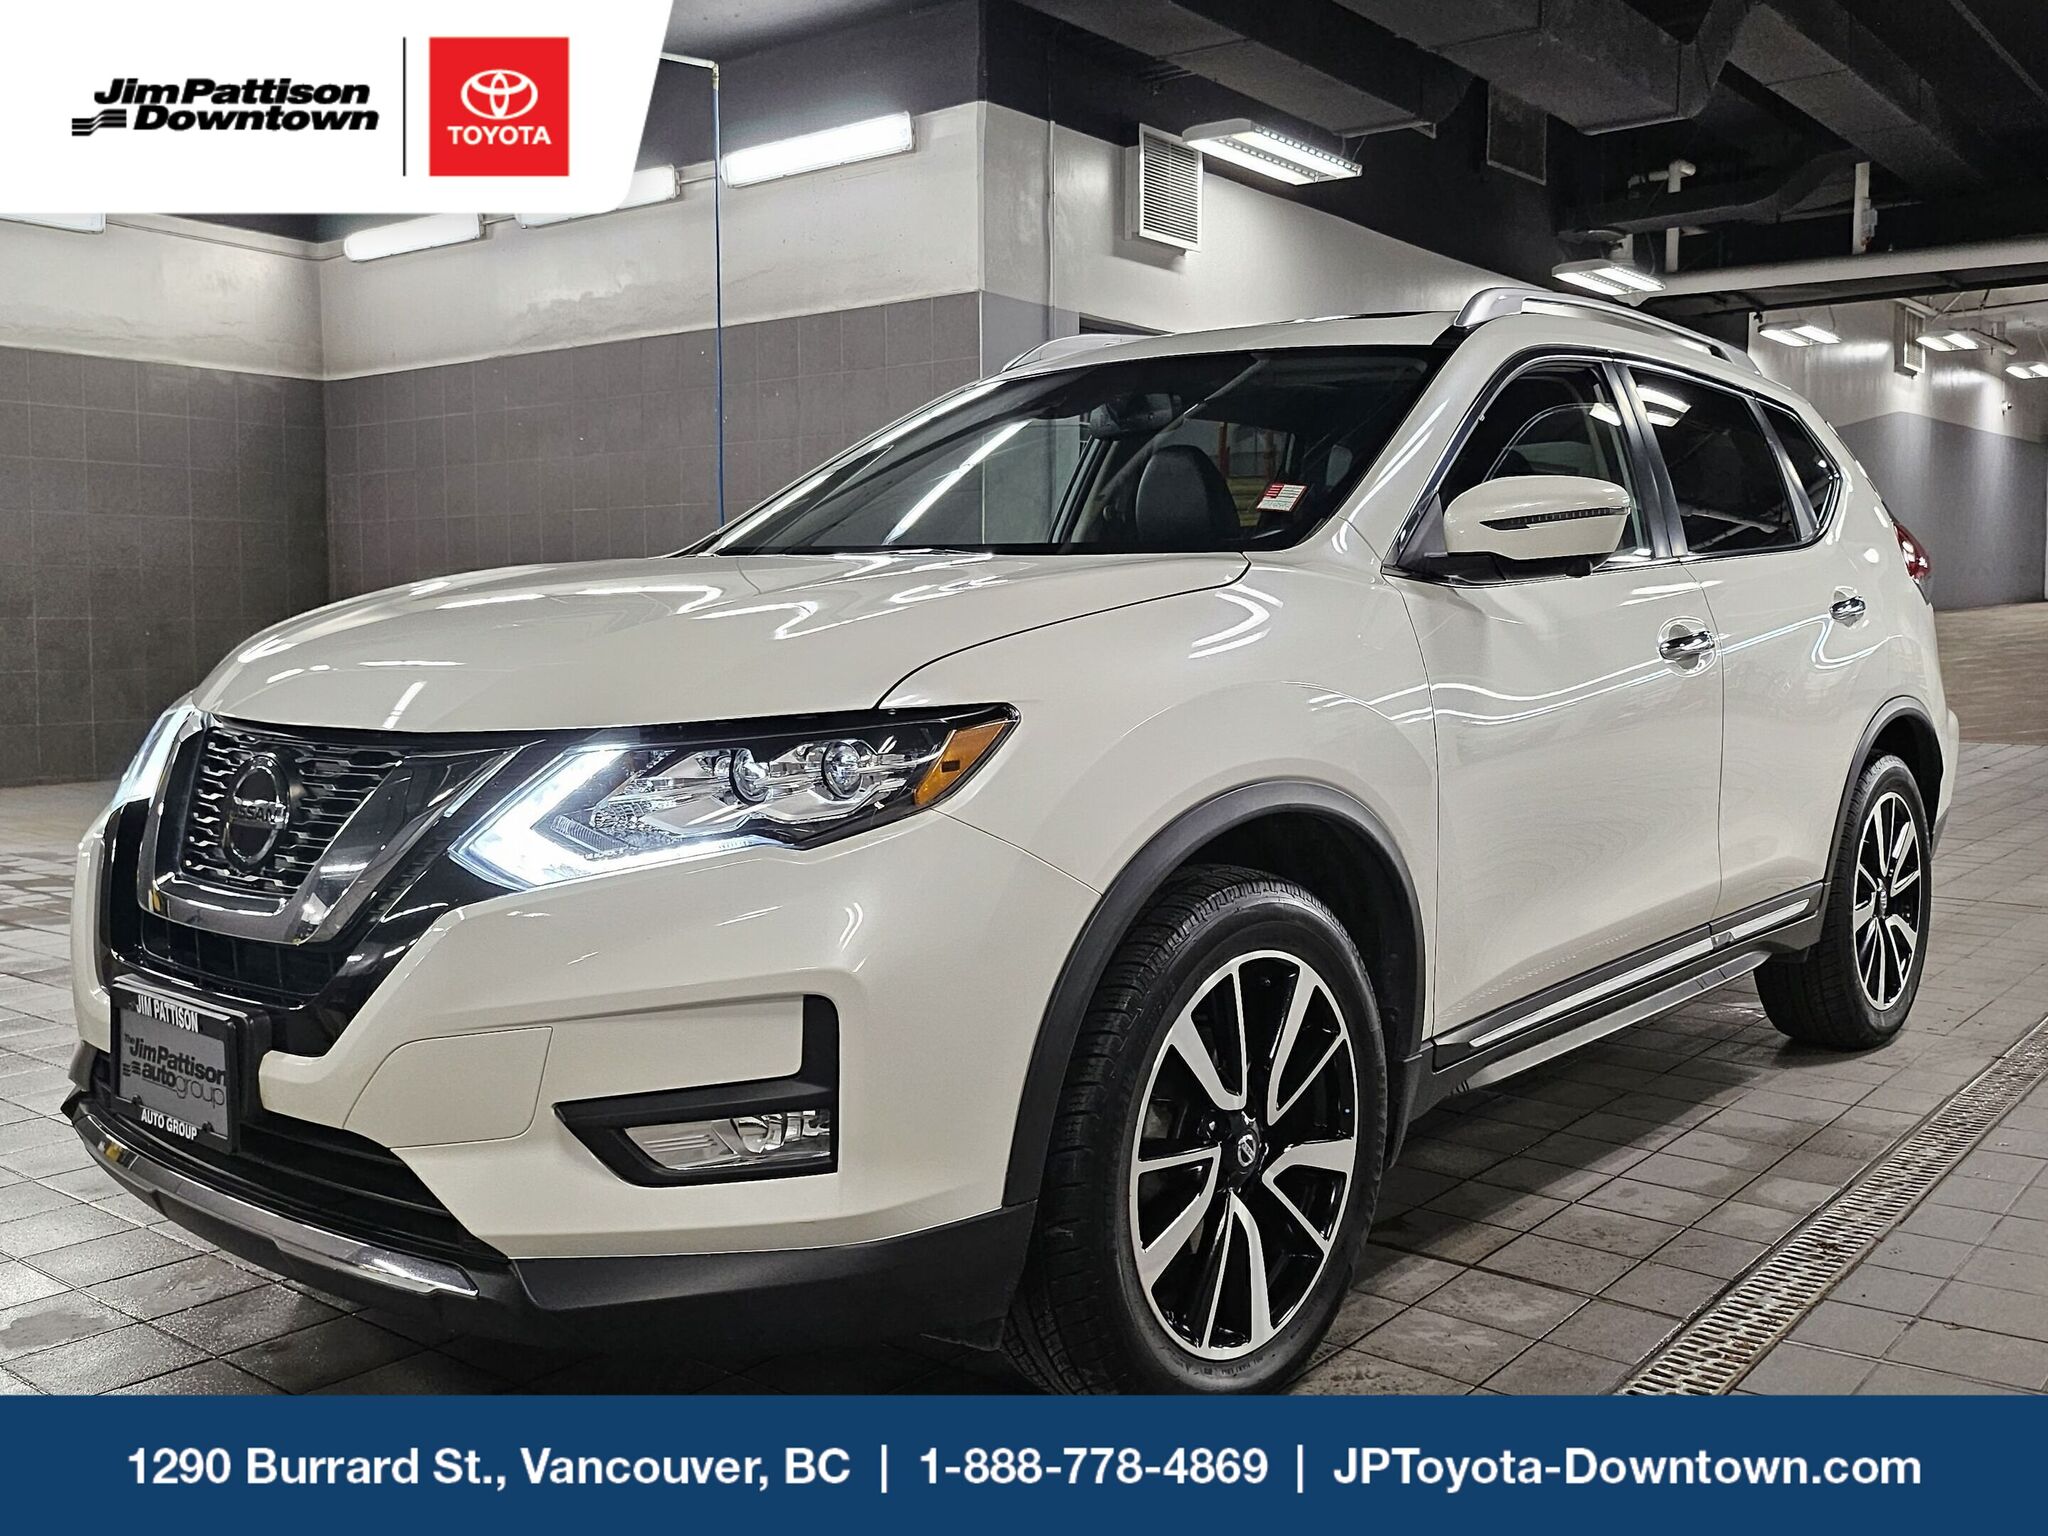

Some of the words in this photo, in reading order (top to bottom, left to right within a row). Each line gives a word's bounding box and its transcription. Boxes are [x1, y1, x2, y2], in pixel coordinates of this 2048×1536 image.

[136, 995, 152, 1016] JIM
[154, 999, 199, 1033] PATTISON
[124, 1034, 135, 1045] The
[141, 1109, 164, 1129] AUTO
[166, 1117, 198, 1141] GROUP
